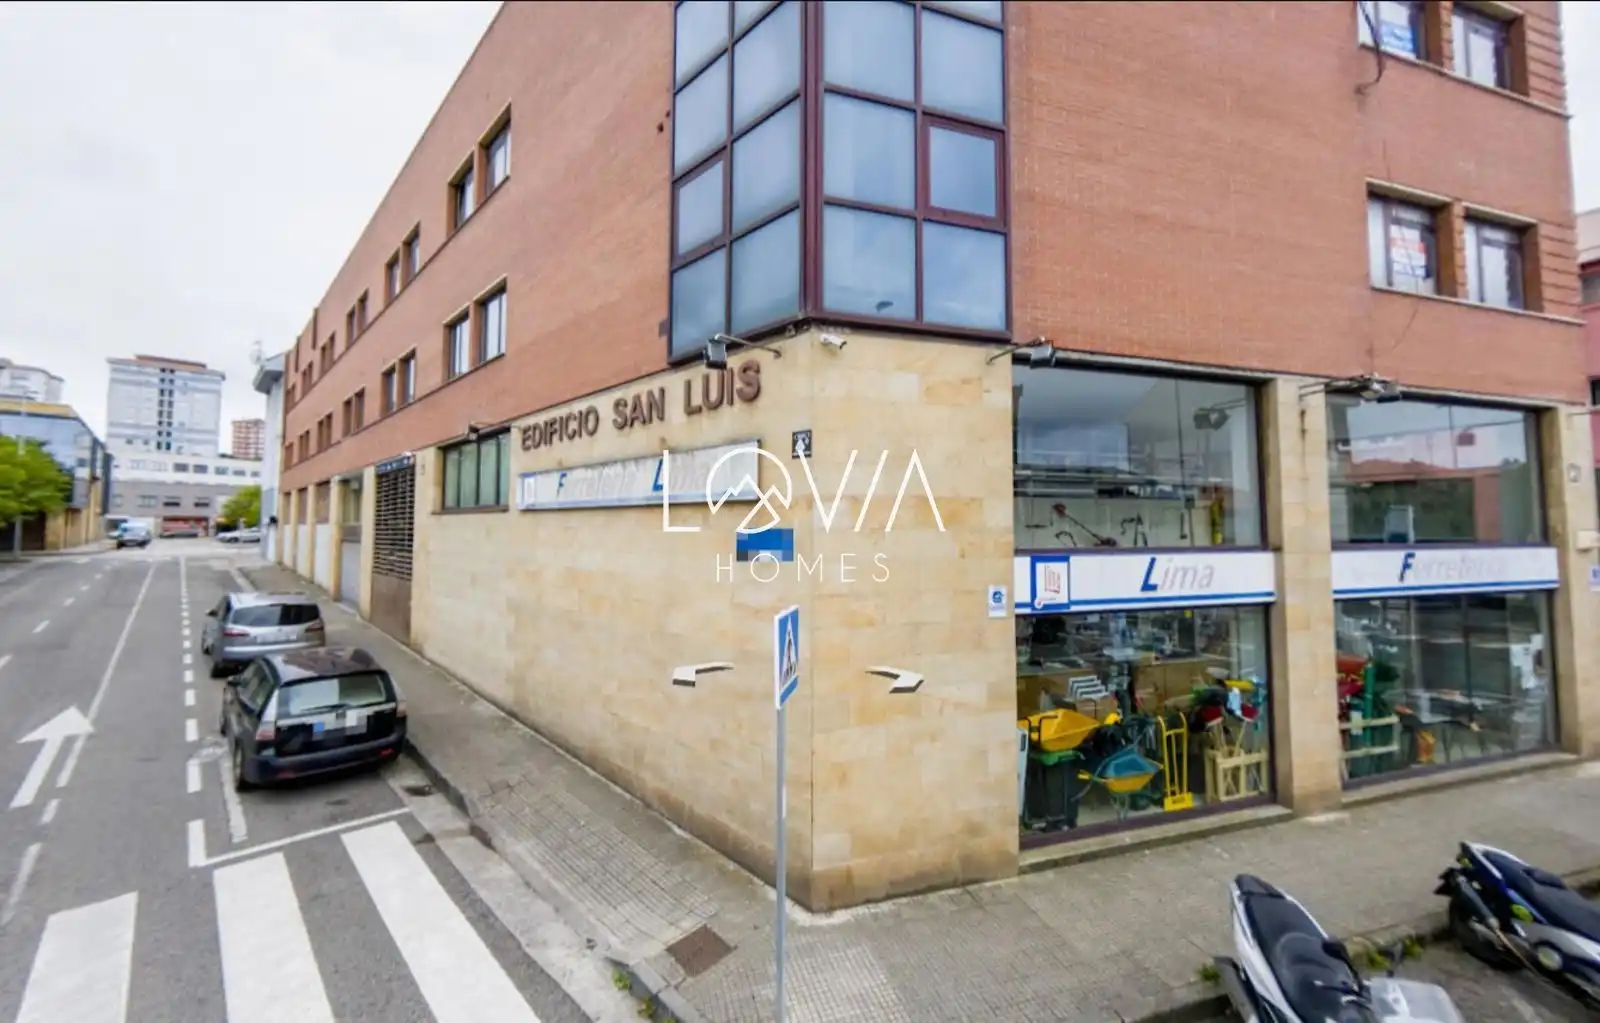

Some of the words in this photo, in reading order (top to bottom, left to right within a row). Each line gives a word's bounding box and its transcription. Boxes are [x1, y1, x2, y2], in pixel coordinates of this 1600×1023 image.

[521, 404, 600, 451] EDIFICIO
[612, 387, 666, 430] SAN
[683, 359, 761, 416] LUIS
[1140, 556, 1215, 592] Lima
